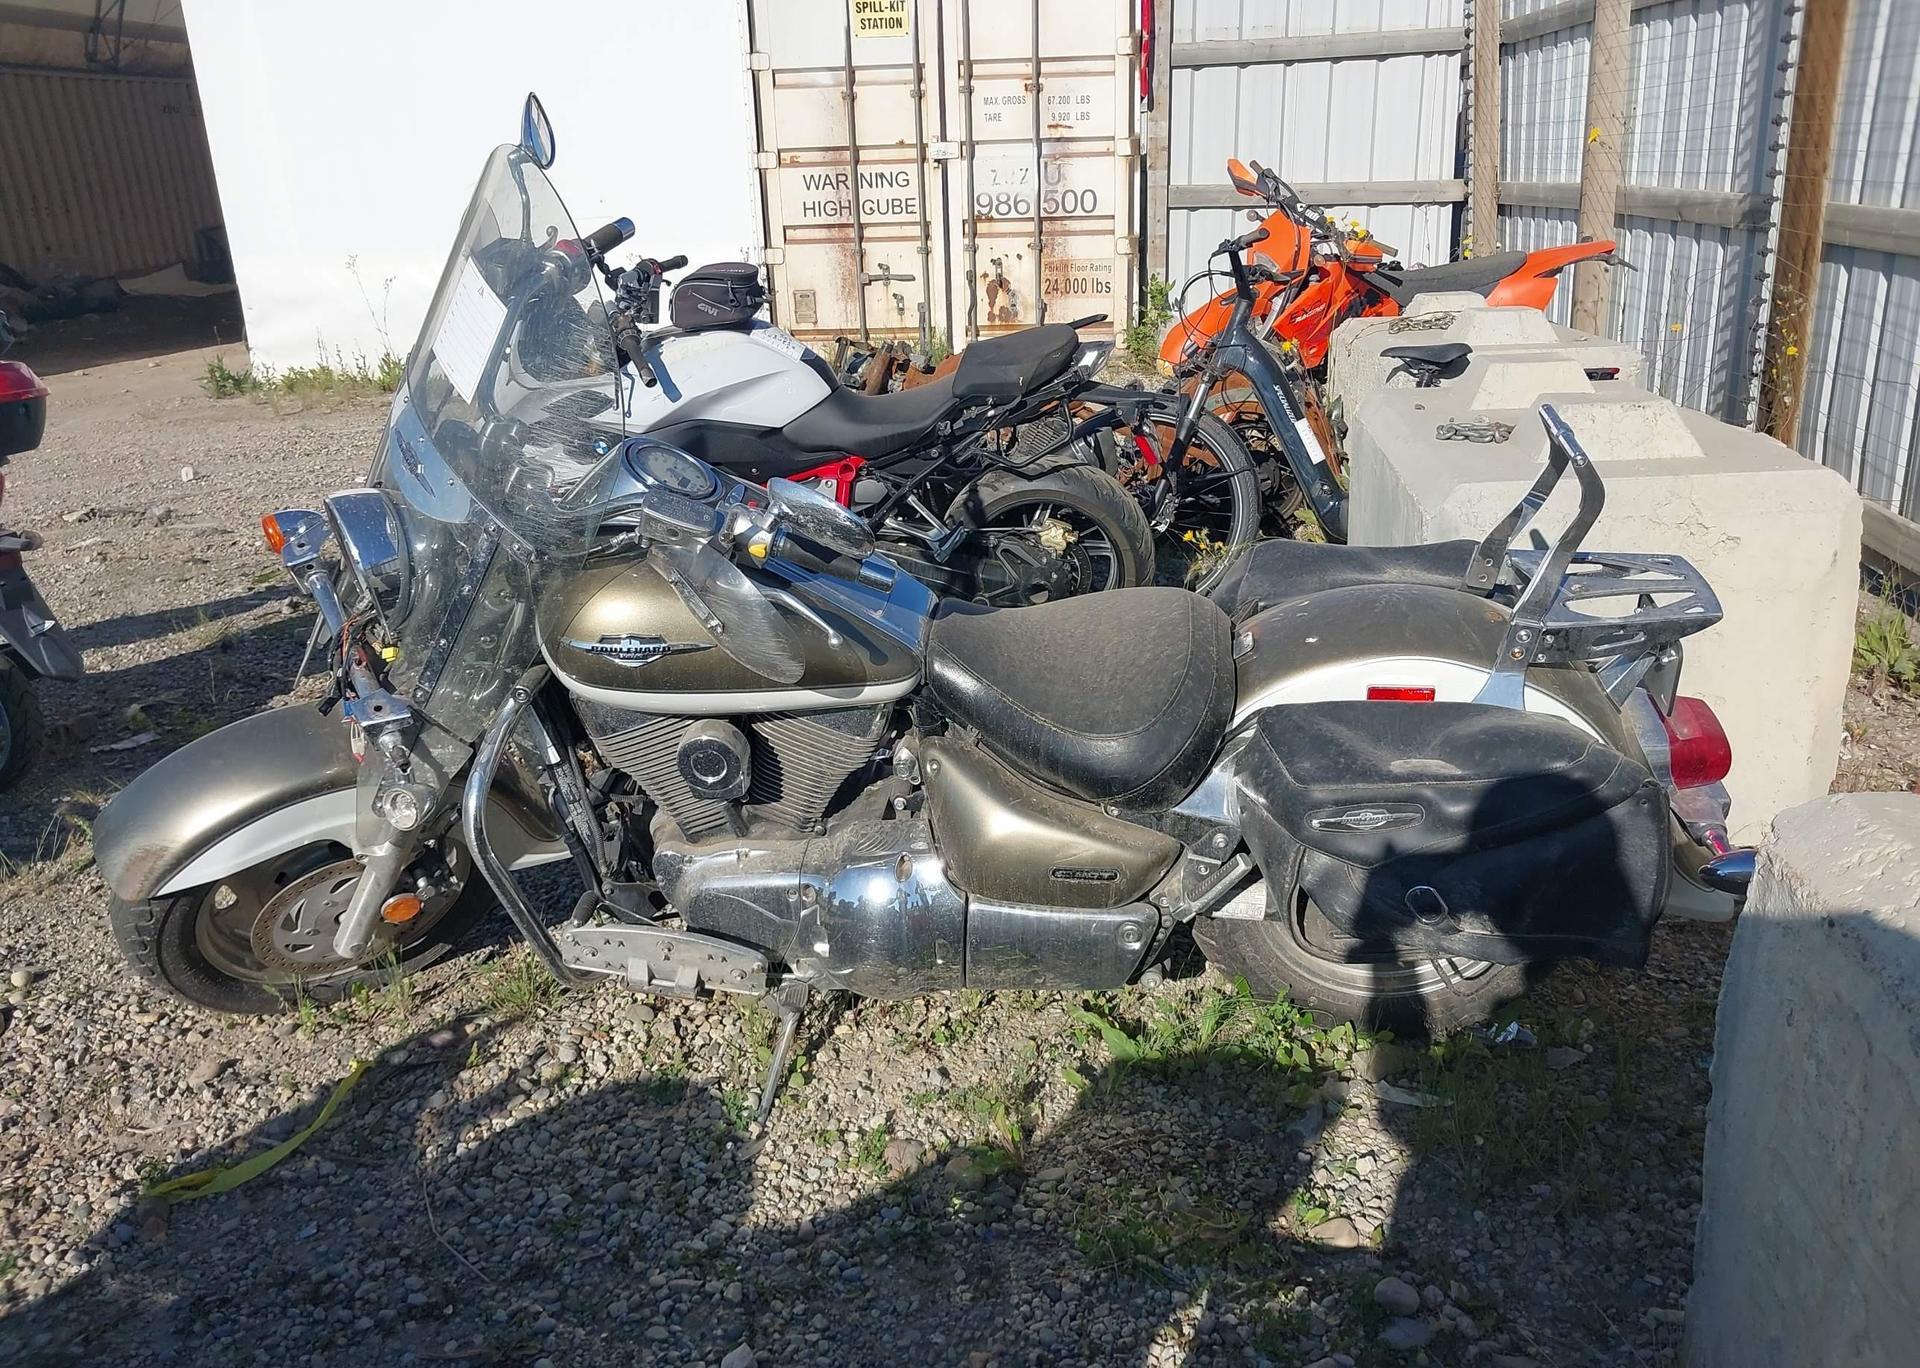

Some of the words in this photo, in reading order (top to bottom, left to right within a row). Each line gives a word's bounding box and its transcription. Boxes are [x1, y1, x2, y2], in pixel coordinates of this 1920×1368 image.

[855, 0, 907, 14] SPILL-KIT
[860, 17, 903, 30] STATION
[1002, 95, 1027, 105] GROSS
[1075, 95, 1091, 105] LBS
[984, 112, 1003, 122] TARE
[1075, 111, 1091, 121] LBS
[802, 171, 910, 191] WARNING
[802, 199, 852, 218] HIGH
[861, 197, 918, 216] CUBE
[1044, 263, 1069, 273] Forklift
[1070, 263, 1089, 273] Floor
[1089, 263, 1112, 274] Rating
[1044, 278, 1088, 297] 24,000
[1091, 277, 1112, 294] lbs
[697, 302, 719, 316] GIVI
